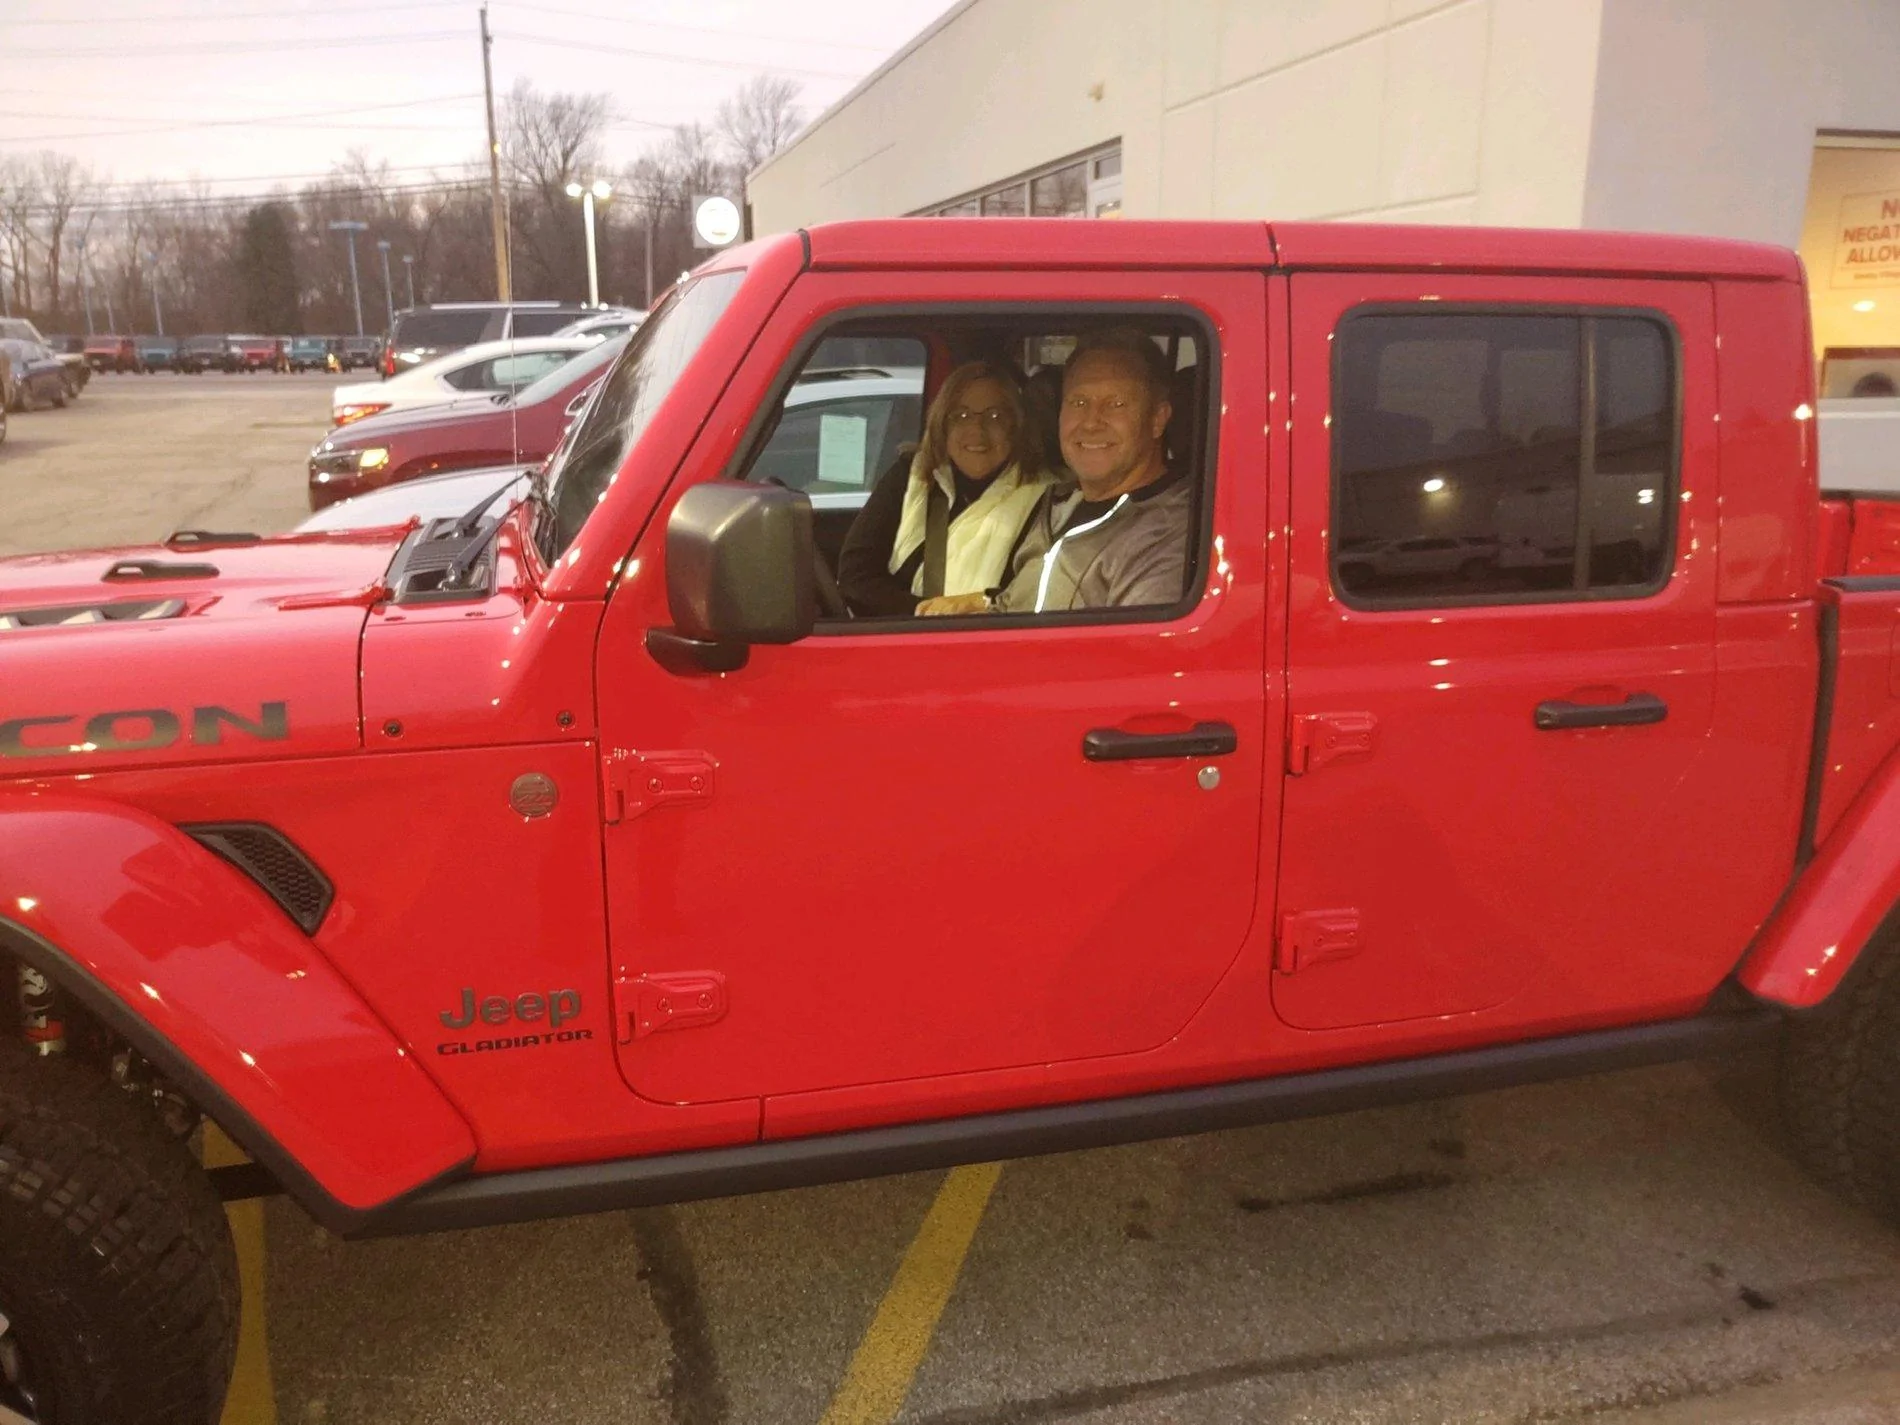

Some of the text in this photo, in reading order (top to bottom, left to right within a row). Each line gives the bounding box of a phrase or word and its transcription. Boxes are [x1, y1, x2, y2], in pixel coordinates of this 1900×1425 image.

[0, 700, 288, 757] CON
[439, 987, 582, 1029] Jeep
[436, 1029, 594, 1056] GLADIATOR
